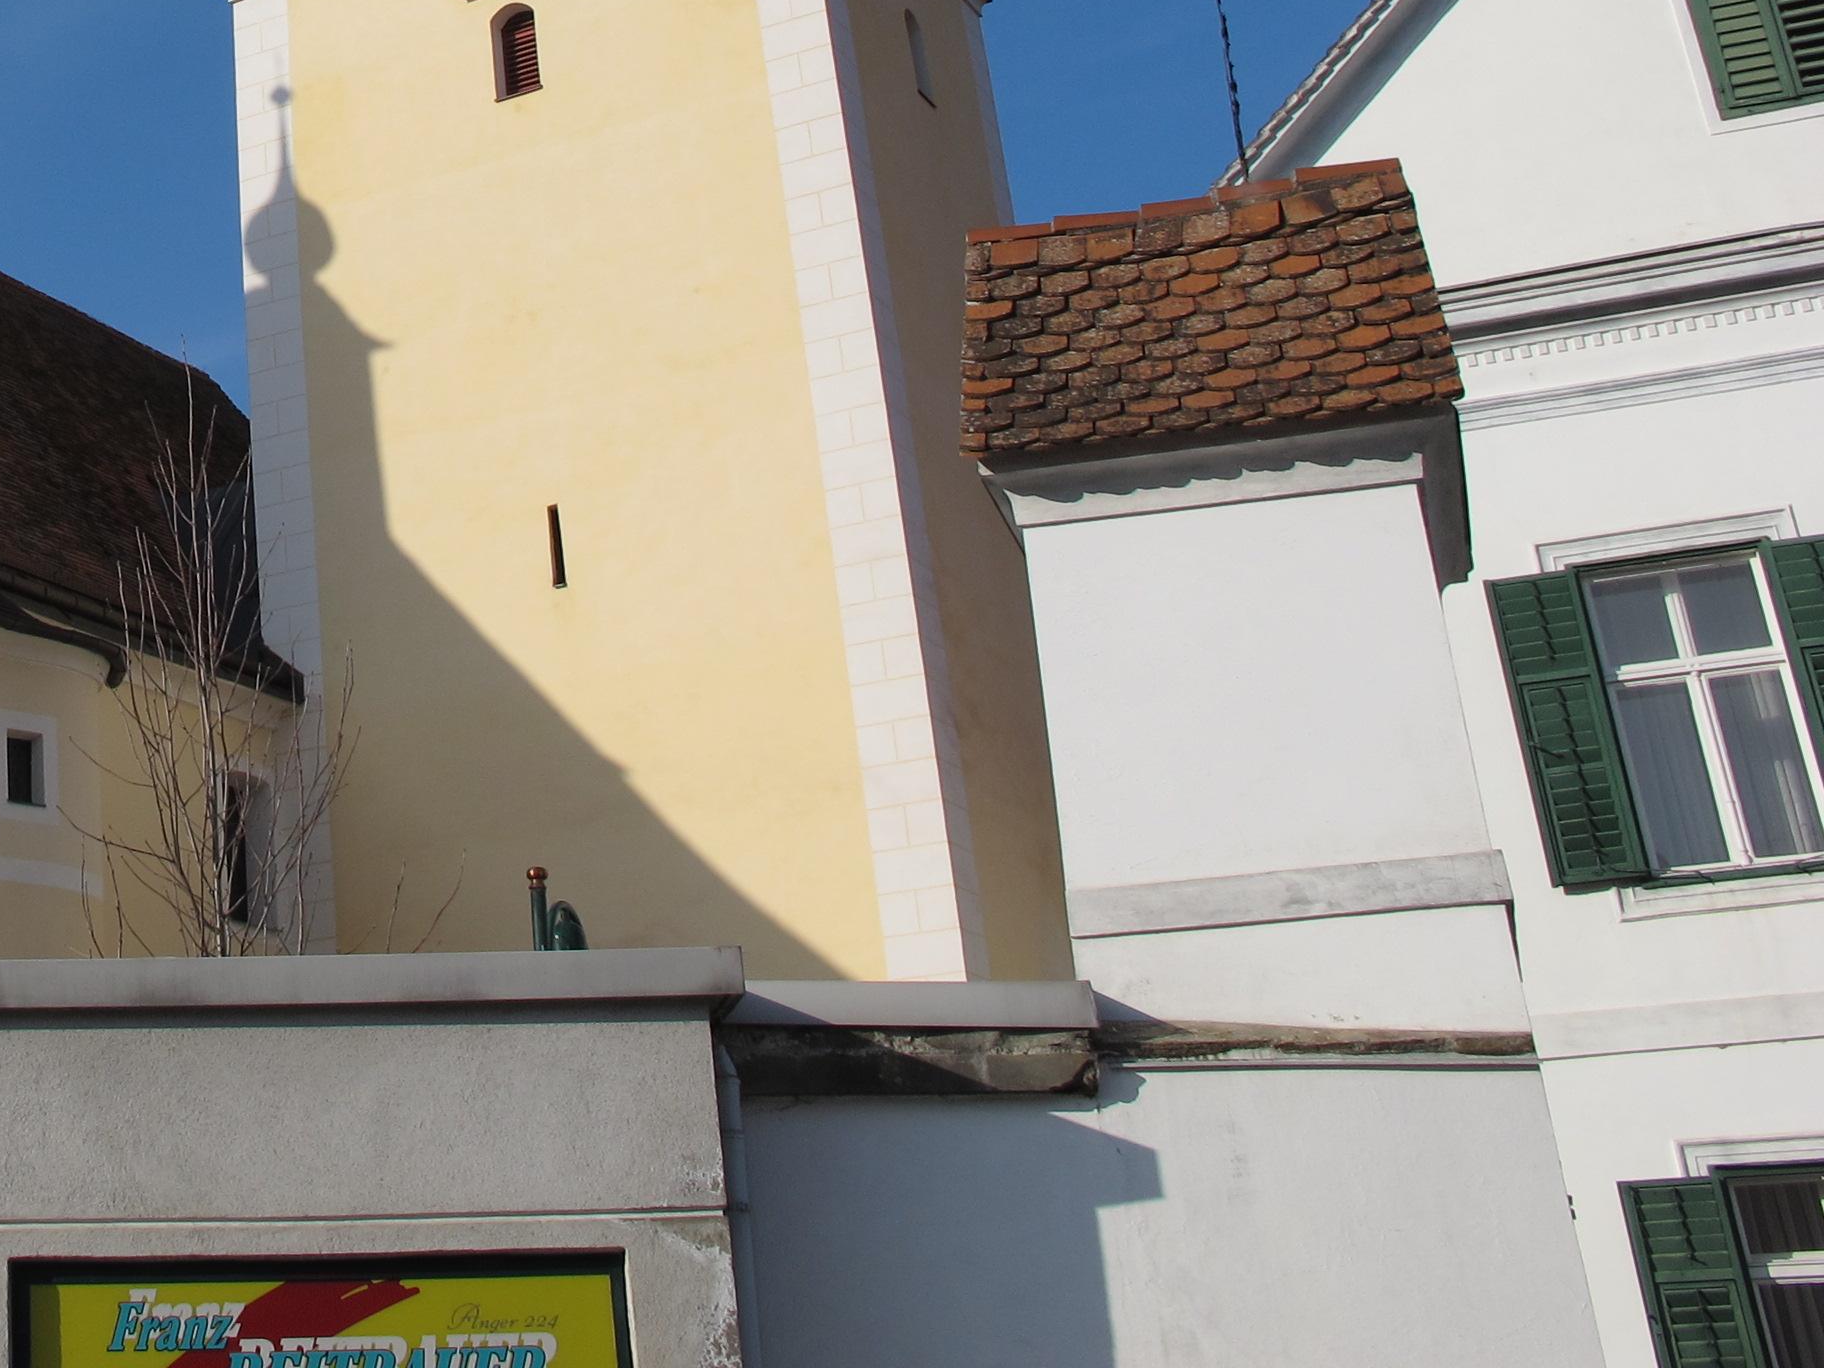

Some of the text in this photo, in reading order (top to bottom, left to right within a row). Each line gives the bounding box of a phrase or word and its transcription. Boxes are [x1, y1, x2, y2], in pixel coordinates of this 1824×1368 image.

[107, 1289, 246, 1352] Franz
[446, 1303, 560, 1332] Anger 224
